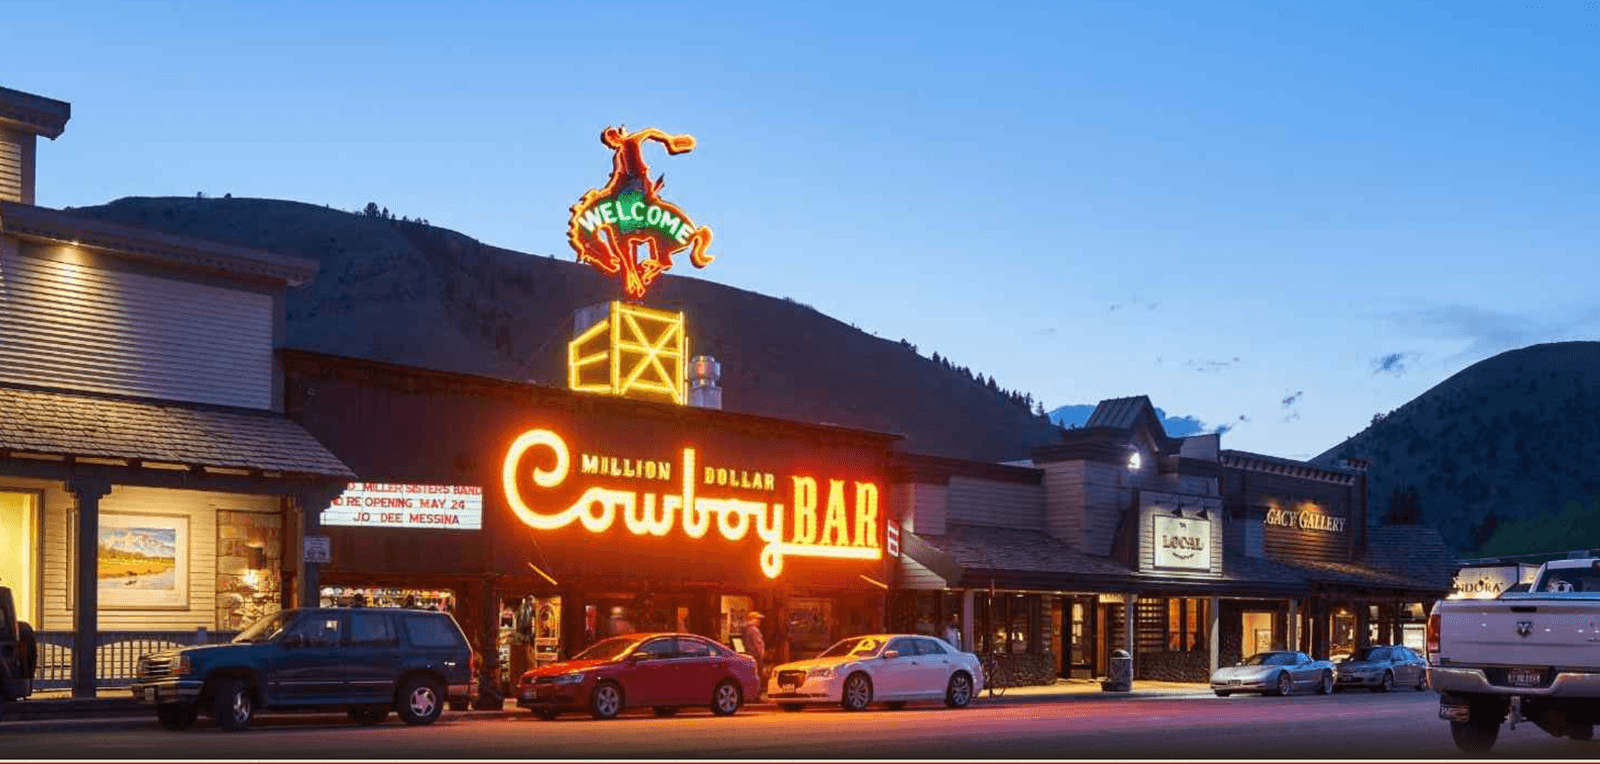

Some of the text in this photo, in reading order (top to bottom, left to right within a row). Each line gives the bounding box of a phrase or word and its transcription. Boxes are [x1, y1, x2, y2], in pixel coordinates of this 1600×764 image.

[578, 200, 695, 244] WELCOME
[580, 453, 776, 492] MILLION DOLLAR
[364, 497, 413, 509] OPENING
[420, 499, 447, 510] MAY
[450, 500, 465, 510] 24
[503, 428, 881, 578] Cowboy BAR
[352, 511, 460, 525] JO DEE MESSINA
[1298, 510, 1347, 532] GALLERY
[1162, 534, 1203, 551] LOCAL
